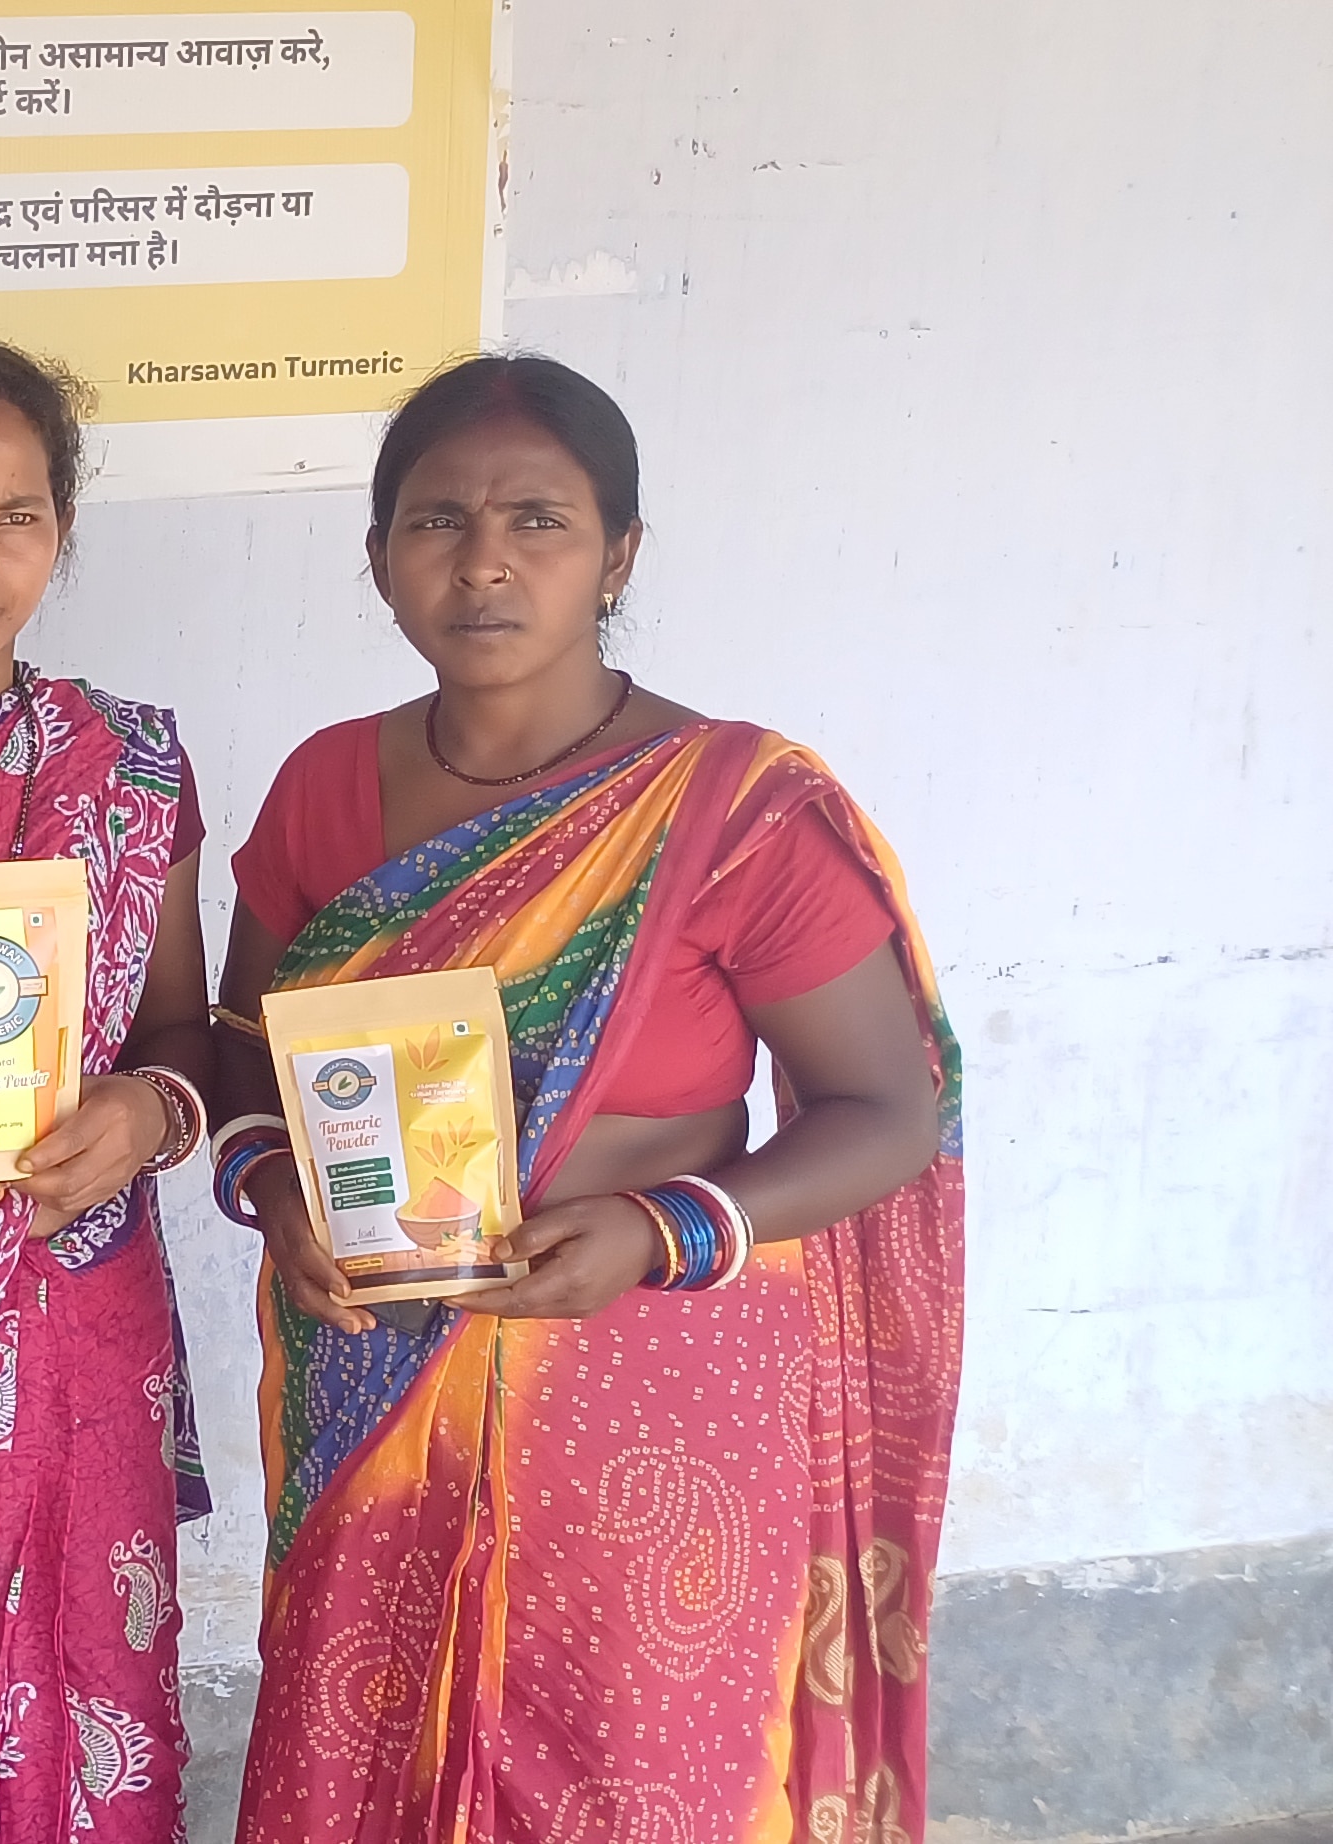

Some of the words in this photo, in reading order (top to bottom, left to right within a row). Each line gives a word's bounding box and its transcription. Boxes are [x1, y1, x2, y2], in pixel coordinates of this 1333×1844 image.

[39, 41, 169, 69] असामान्य
[176, 40, 273, 70] आवाज़
[280, 29, 330, 70] करे,
[15, 78, 71, 115] करें।
[20, 191, 63, 231] एवं
[71, 187, 157, 223] परिसर
[164, 185, 187, 221] में
[194, 185, 275, 226] दौड़ना
[282, 191, 313, 217] या
[86, 240, 139, 267] मना
[146, 231, 179, 270] है।
[127, 361, 277, 385] Kharsawan
[284, 351, 404, 379] Turmeric
[318, 1115, 383, 1135] Turmeric
[326, 1133, 379, 1153] Powder
